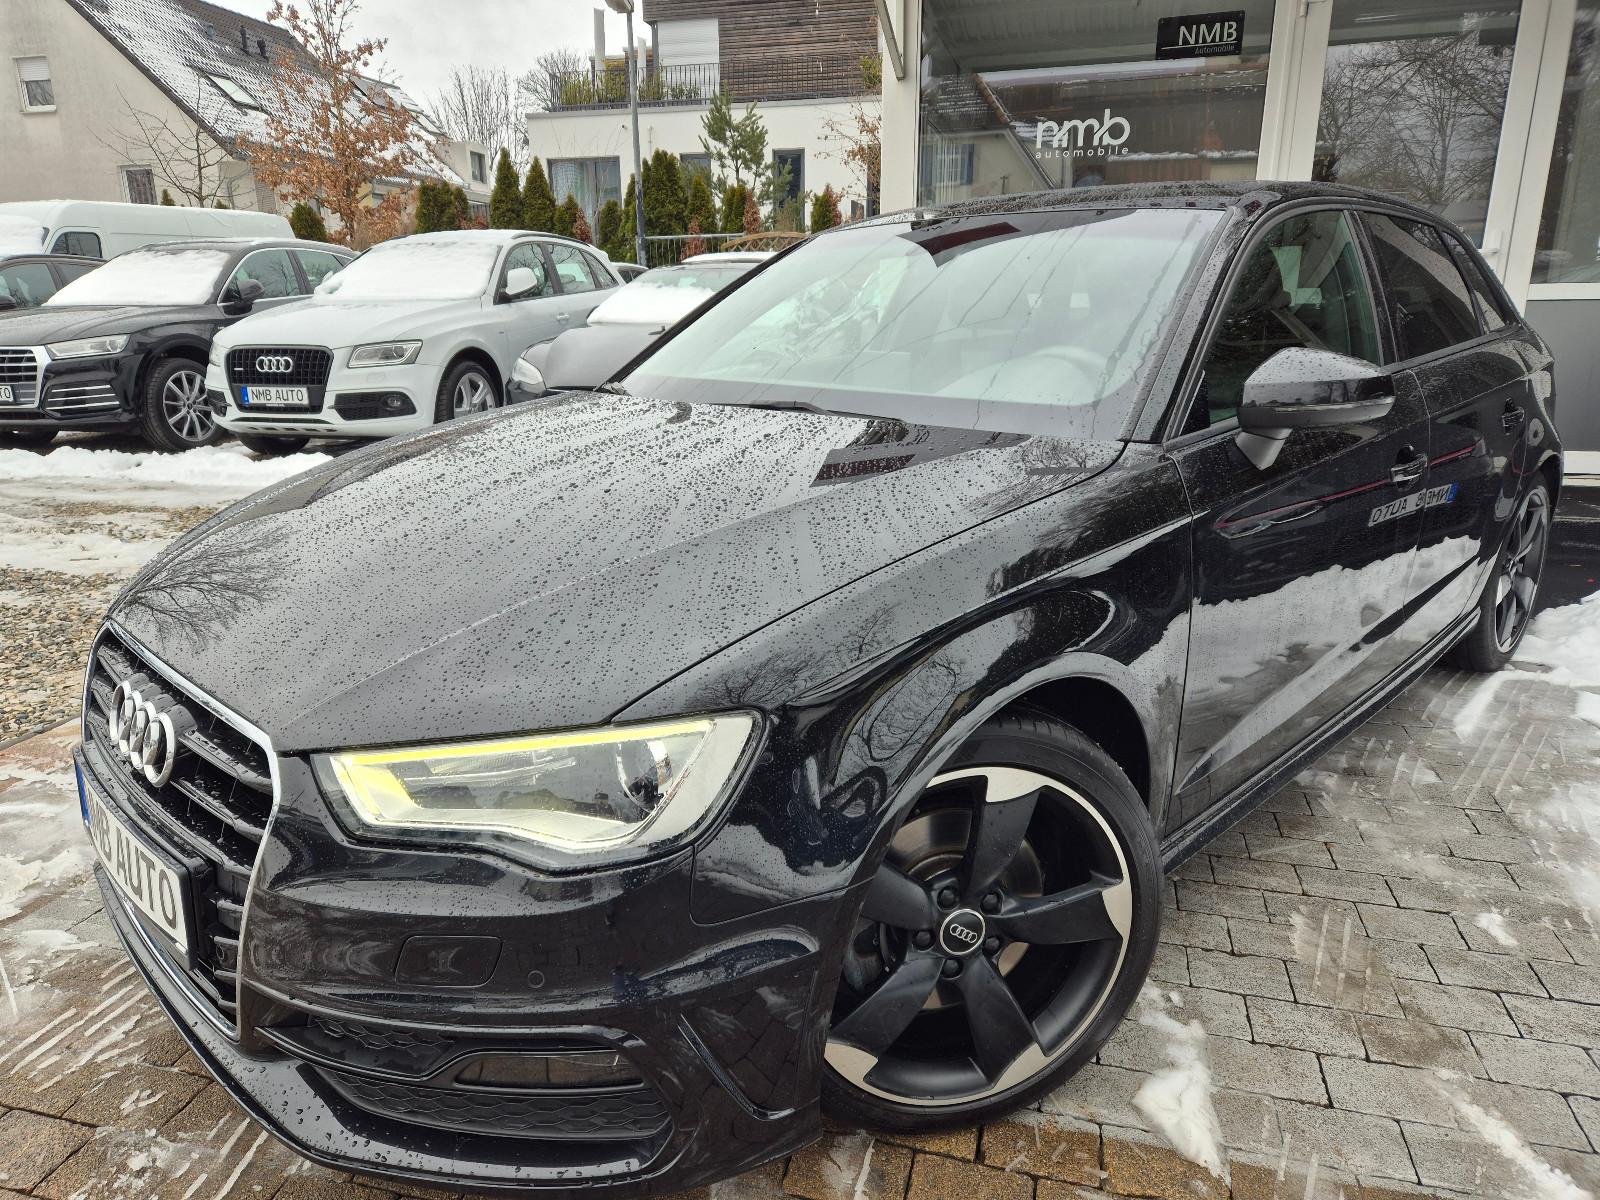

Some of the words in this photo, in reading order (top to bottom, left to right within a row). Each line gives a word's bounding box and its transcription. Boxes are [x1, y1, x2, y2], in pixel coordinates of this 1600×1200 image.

[1178, 21, 1237, 46] NMB
[1194, 44, 1235, 54] Automobile
[1036, 108, 1131, 149] nmb
[1035, 145, 1129, 158] automobile
[250, 388, 272, 402] NMB
[275, 389, 304, 402] AUTO
[116, 825, 177, 930] AUTO
